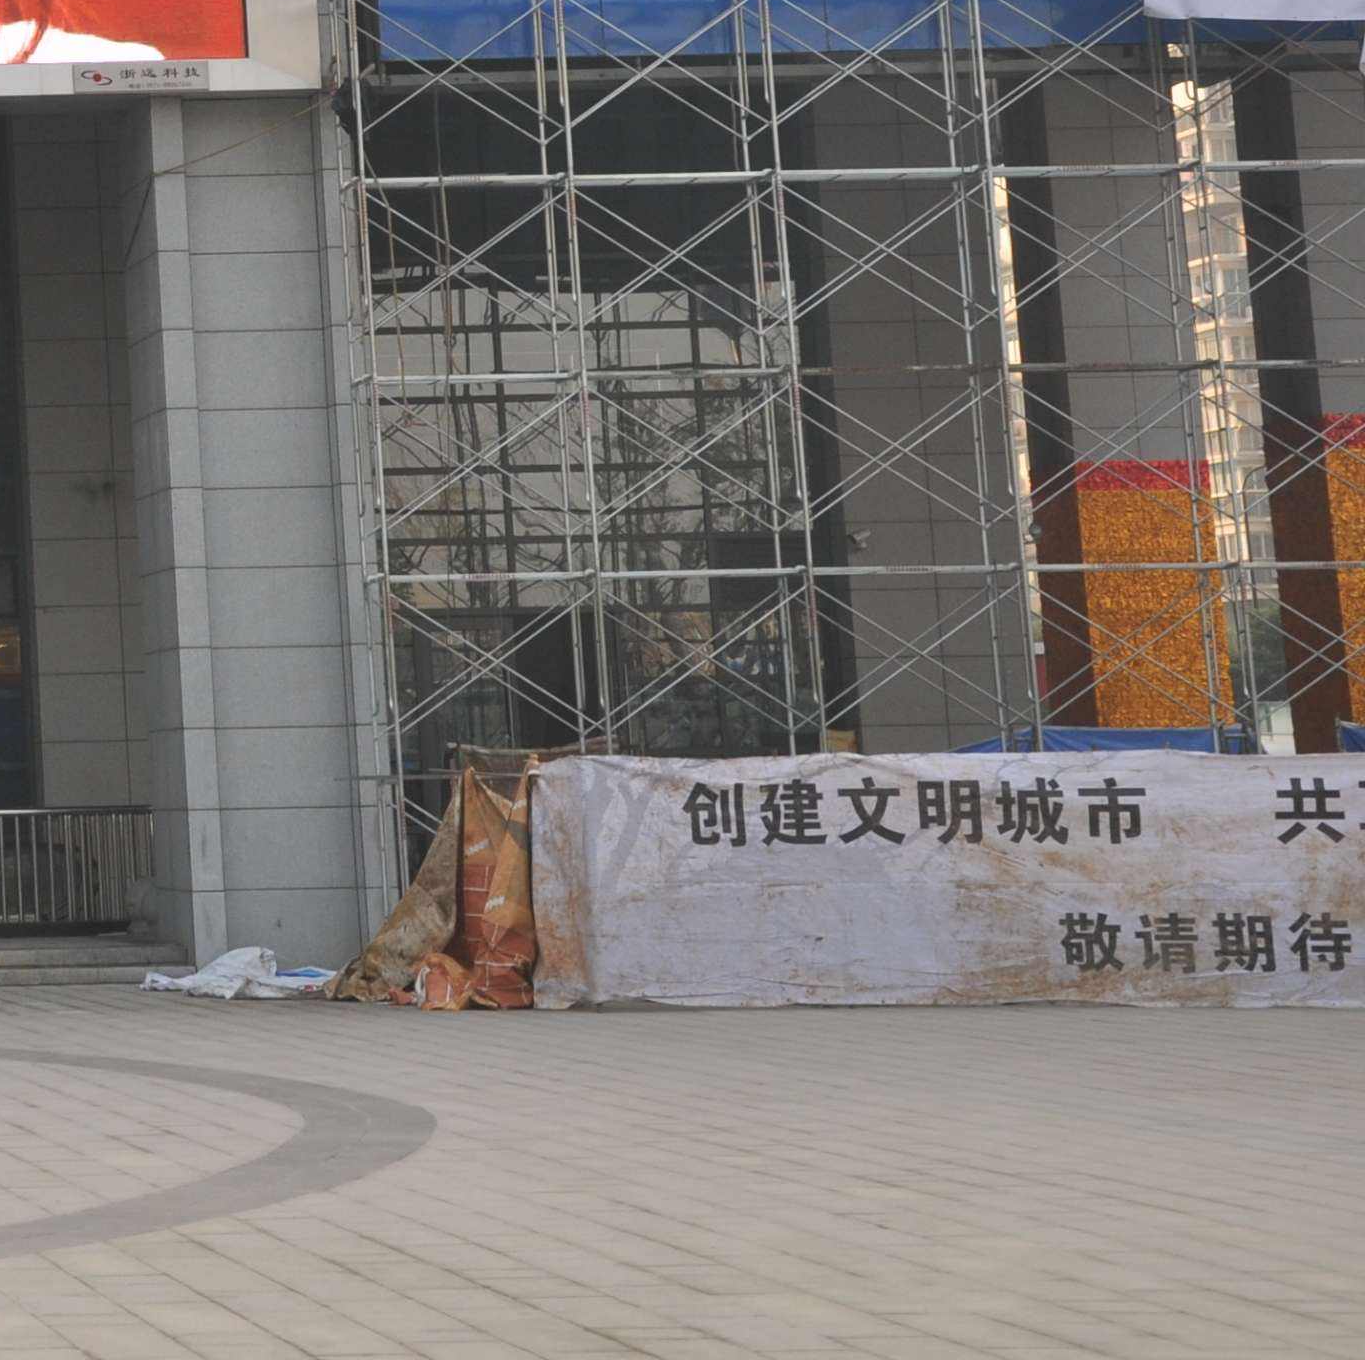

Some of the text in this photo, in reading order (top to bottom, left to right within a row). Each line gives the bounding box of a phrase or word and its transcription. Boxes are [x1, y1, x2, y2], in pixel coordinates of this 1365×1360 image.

[681, 776, 1365, 848] 创建文明城市 共
[1058, 912, 1352, 973] 敬请期待
